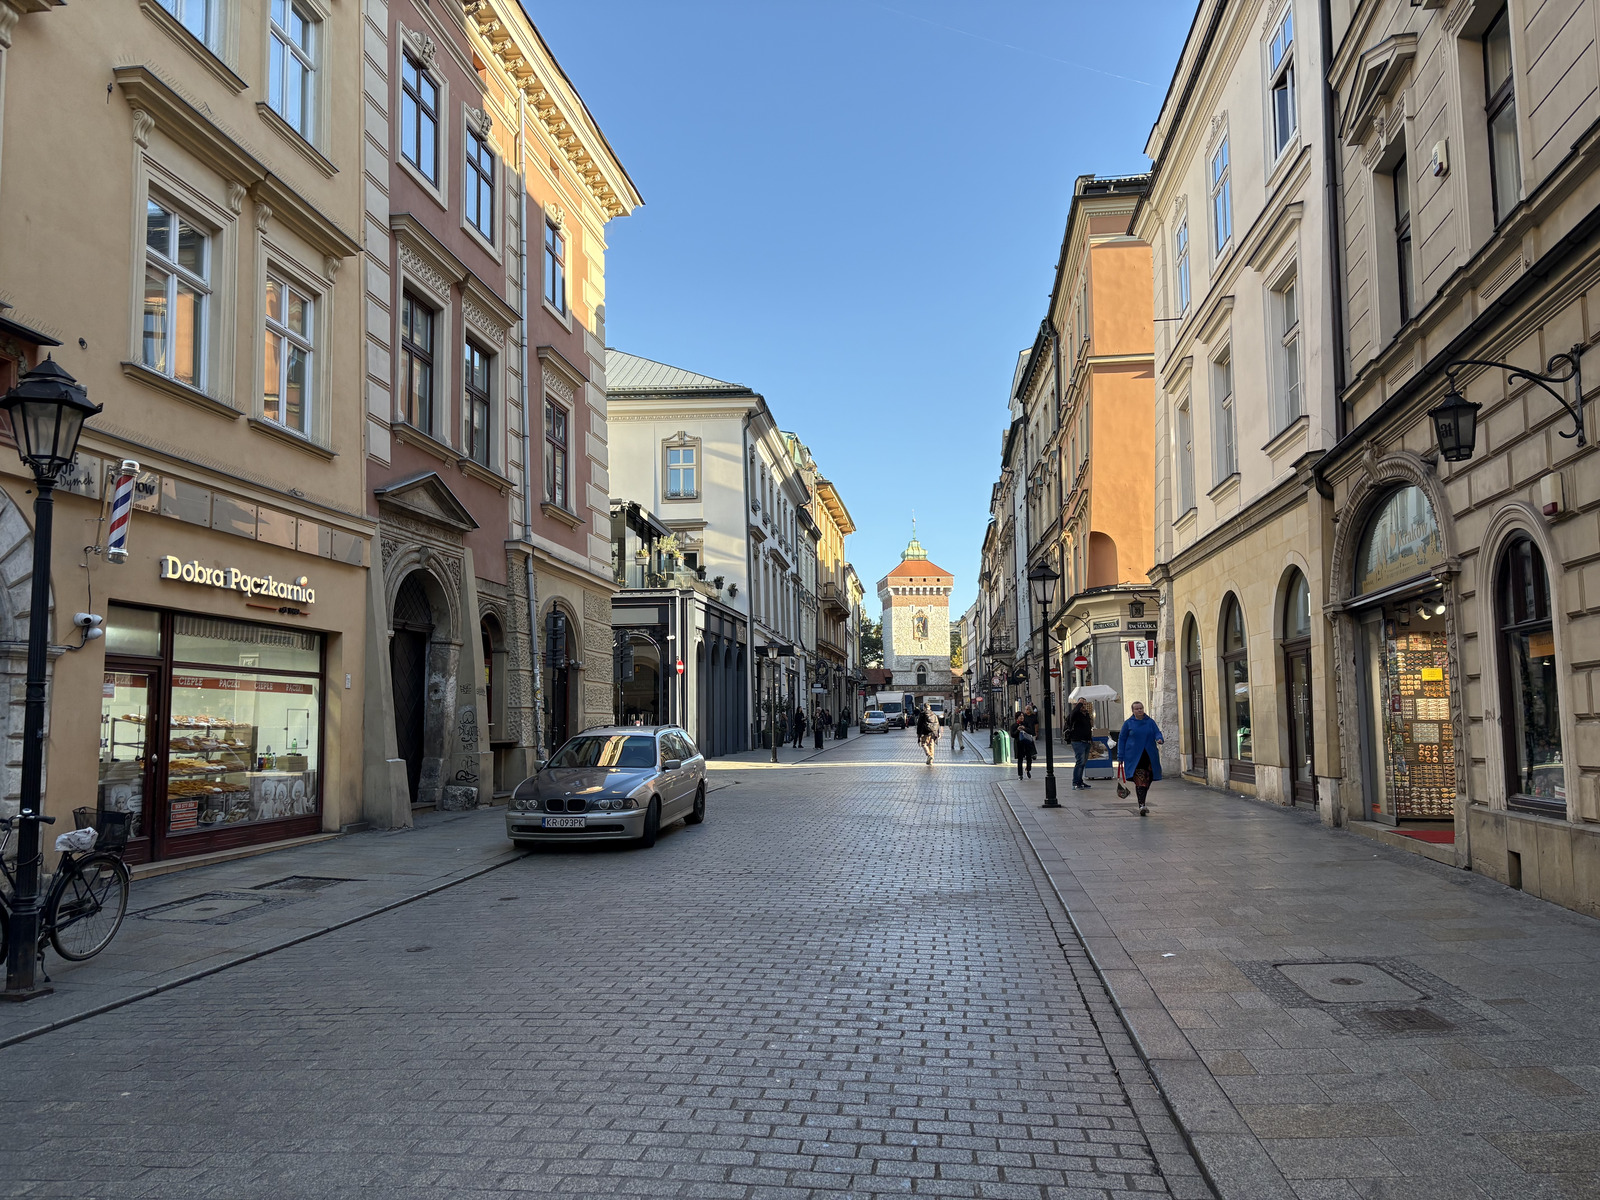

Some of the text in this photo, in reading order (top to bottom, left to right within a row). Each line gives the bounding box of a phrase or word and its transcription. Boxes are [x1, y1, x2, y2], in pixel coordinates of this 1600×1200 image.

[1440, 422, 1453, 438] 31
[60, 472, 94, 491] Dymek
[1399, 522, 1428, 548] Kraków
[165, 555, 315, 604] Dobra Pączkarnia
[546, 818, 584, 827] KR 093PK
